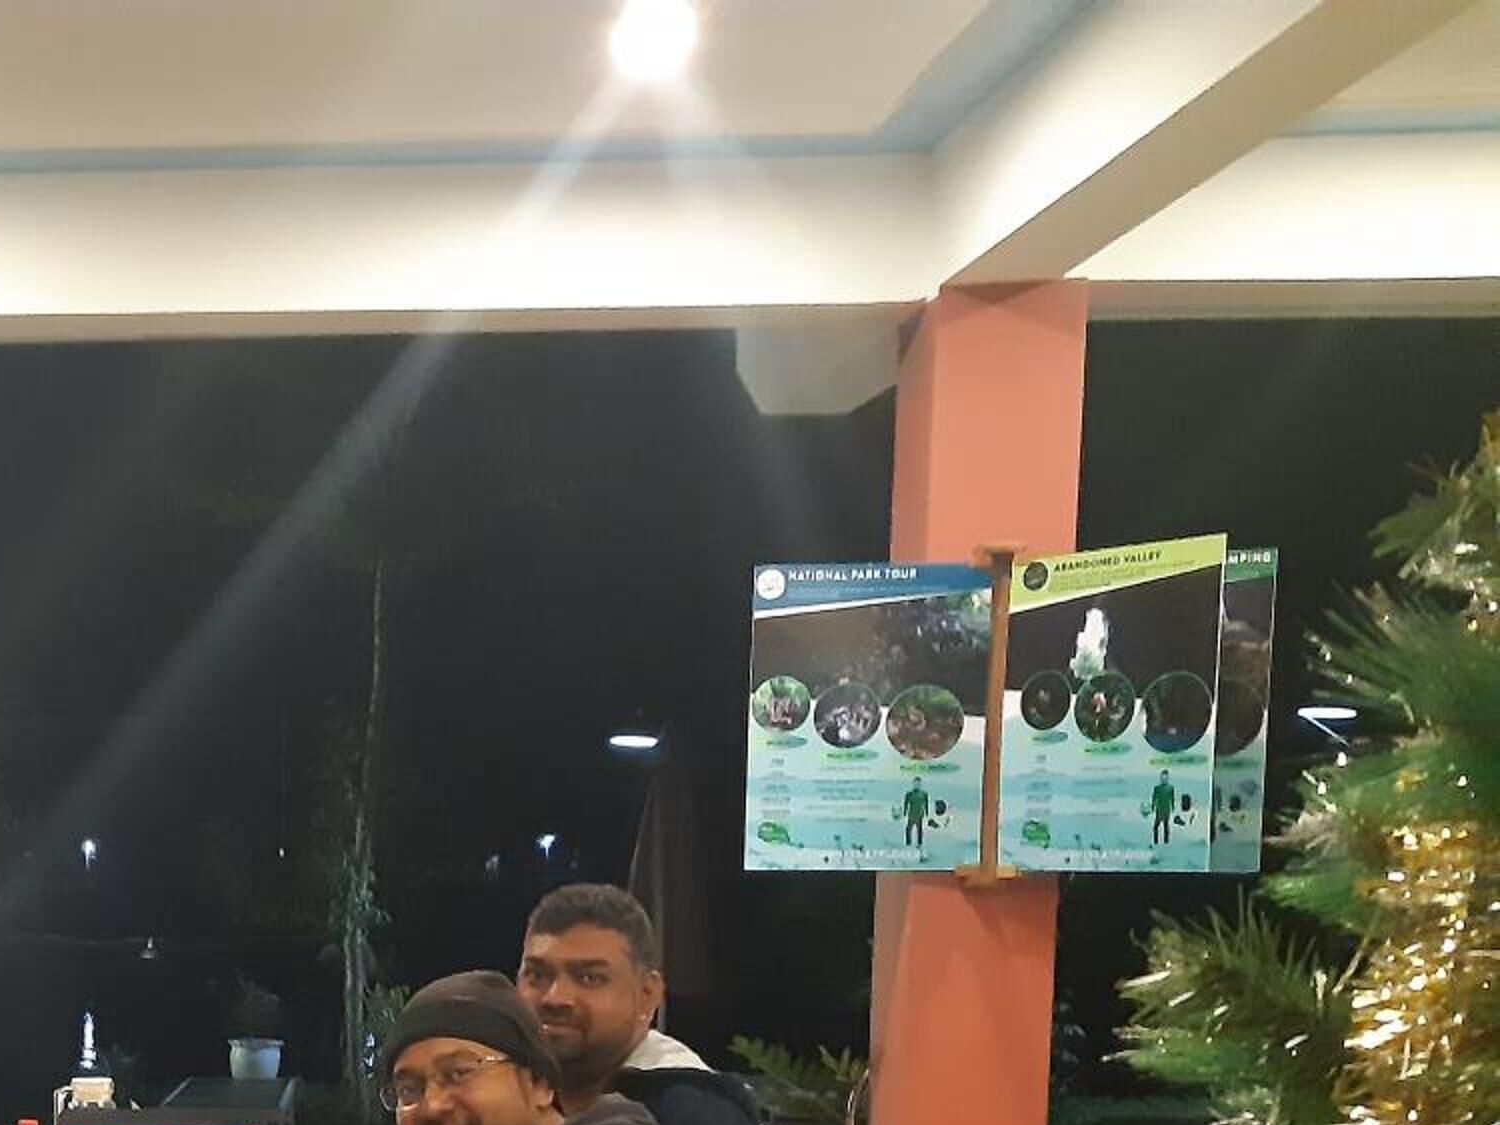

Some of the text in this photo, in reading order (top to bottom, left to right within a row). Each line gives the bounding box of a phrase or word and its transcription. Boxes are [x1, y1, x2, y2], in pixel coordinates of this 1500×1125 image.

[1054, 551, 1162, 572] ABANDONED VALLEY
[788, 567, 918, 582] NATIONAL PARK TOUR
